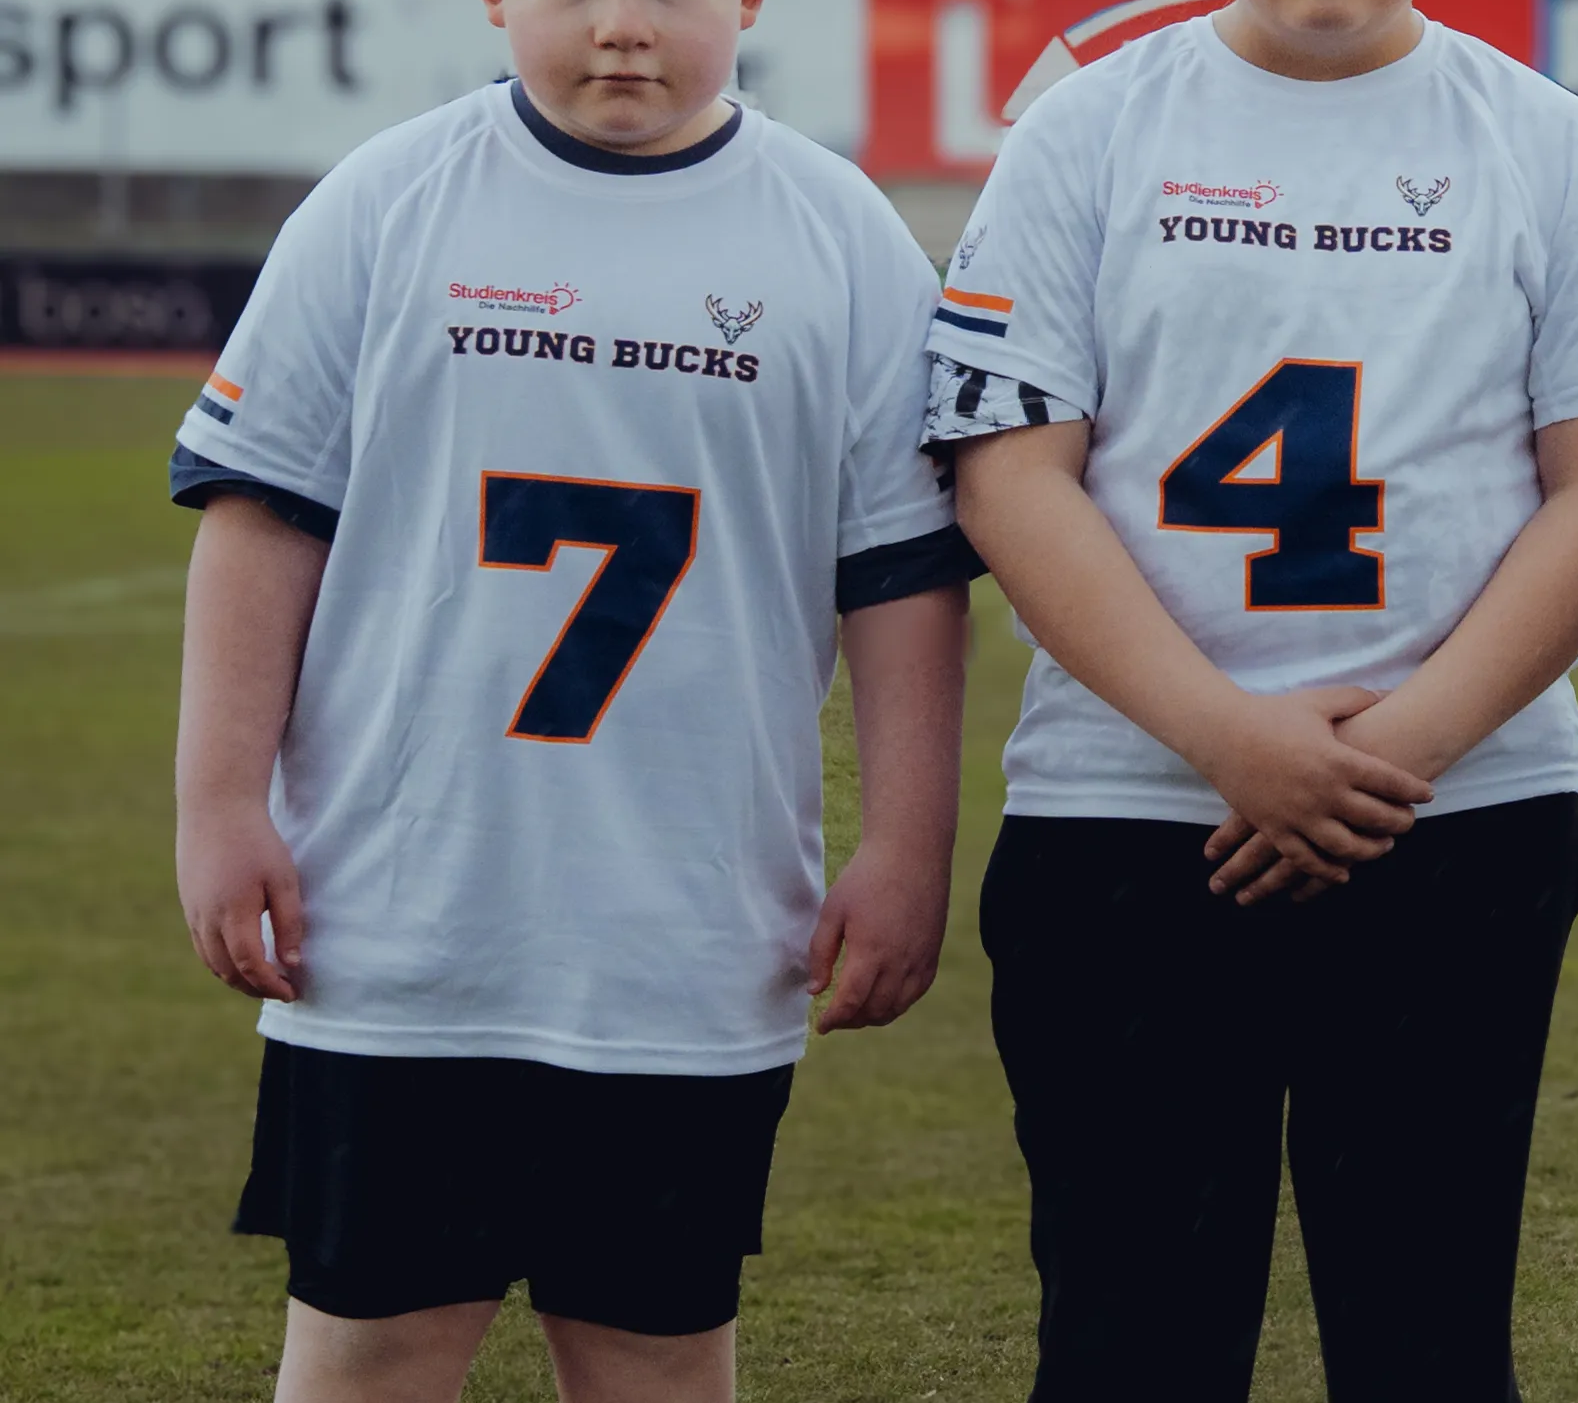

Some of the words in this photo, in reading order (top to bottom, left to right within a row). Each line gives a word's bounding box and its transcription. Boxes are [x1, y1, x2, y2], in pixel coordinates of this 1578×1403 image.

[1162, 180, 1262, 202] Studienkreis
[1189, 195, 1203, 205] Die
[1159, 215, 1297, 250] YOUNG
[1313, 224, 1452, 253] BUCKS
[449, 282, 559, 306] Studienkreis
[478, 301, 495, 310] Die
[447, 326, 596, 365] YOUNG
[611, 338, 760, 383] BUCKS
[1157, 357, 1386, 611] 4
[479, 469, 701, 743] 7
